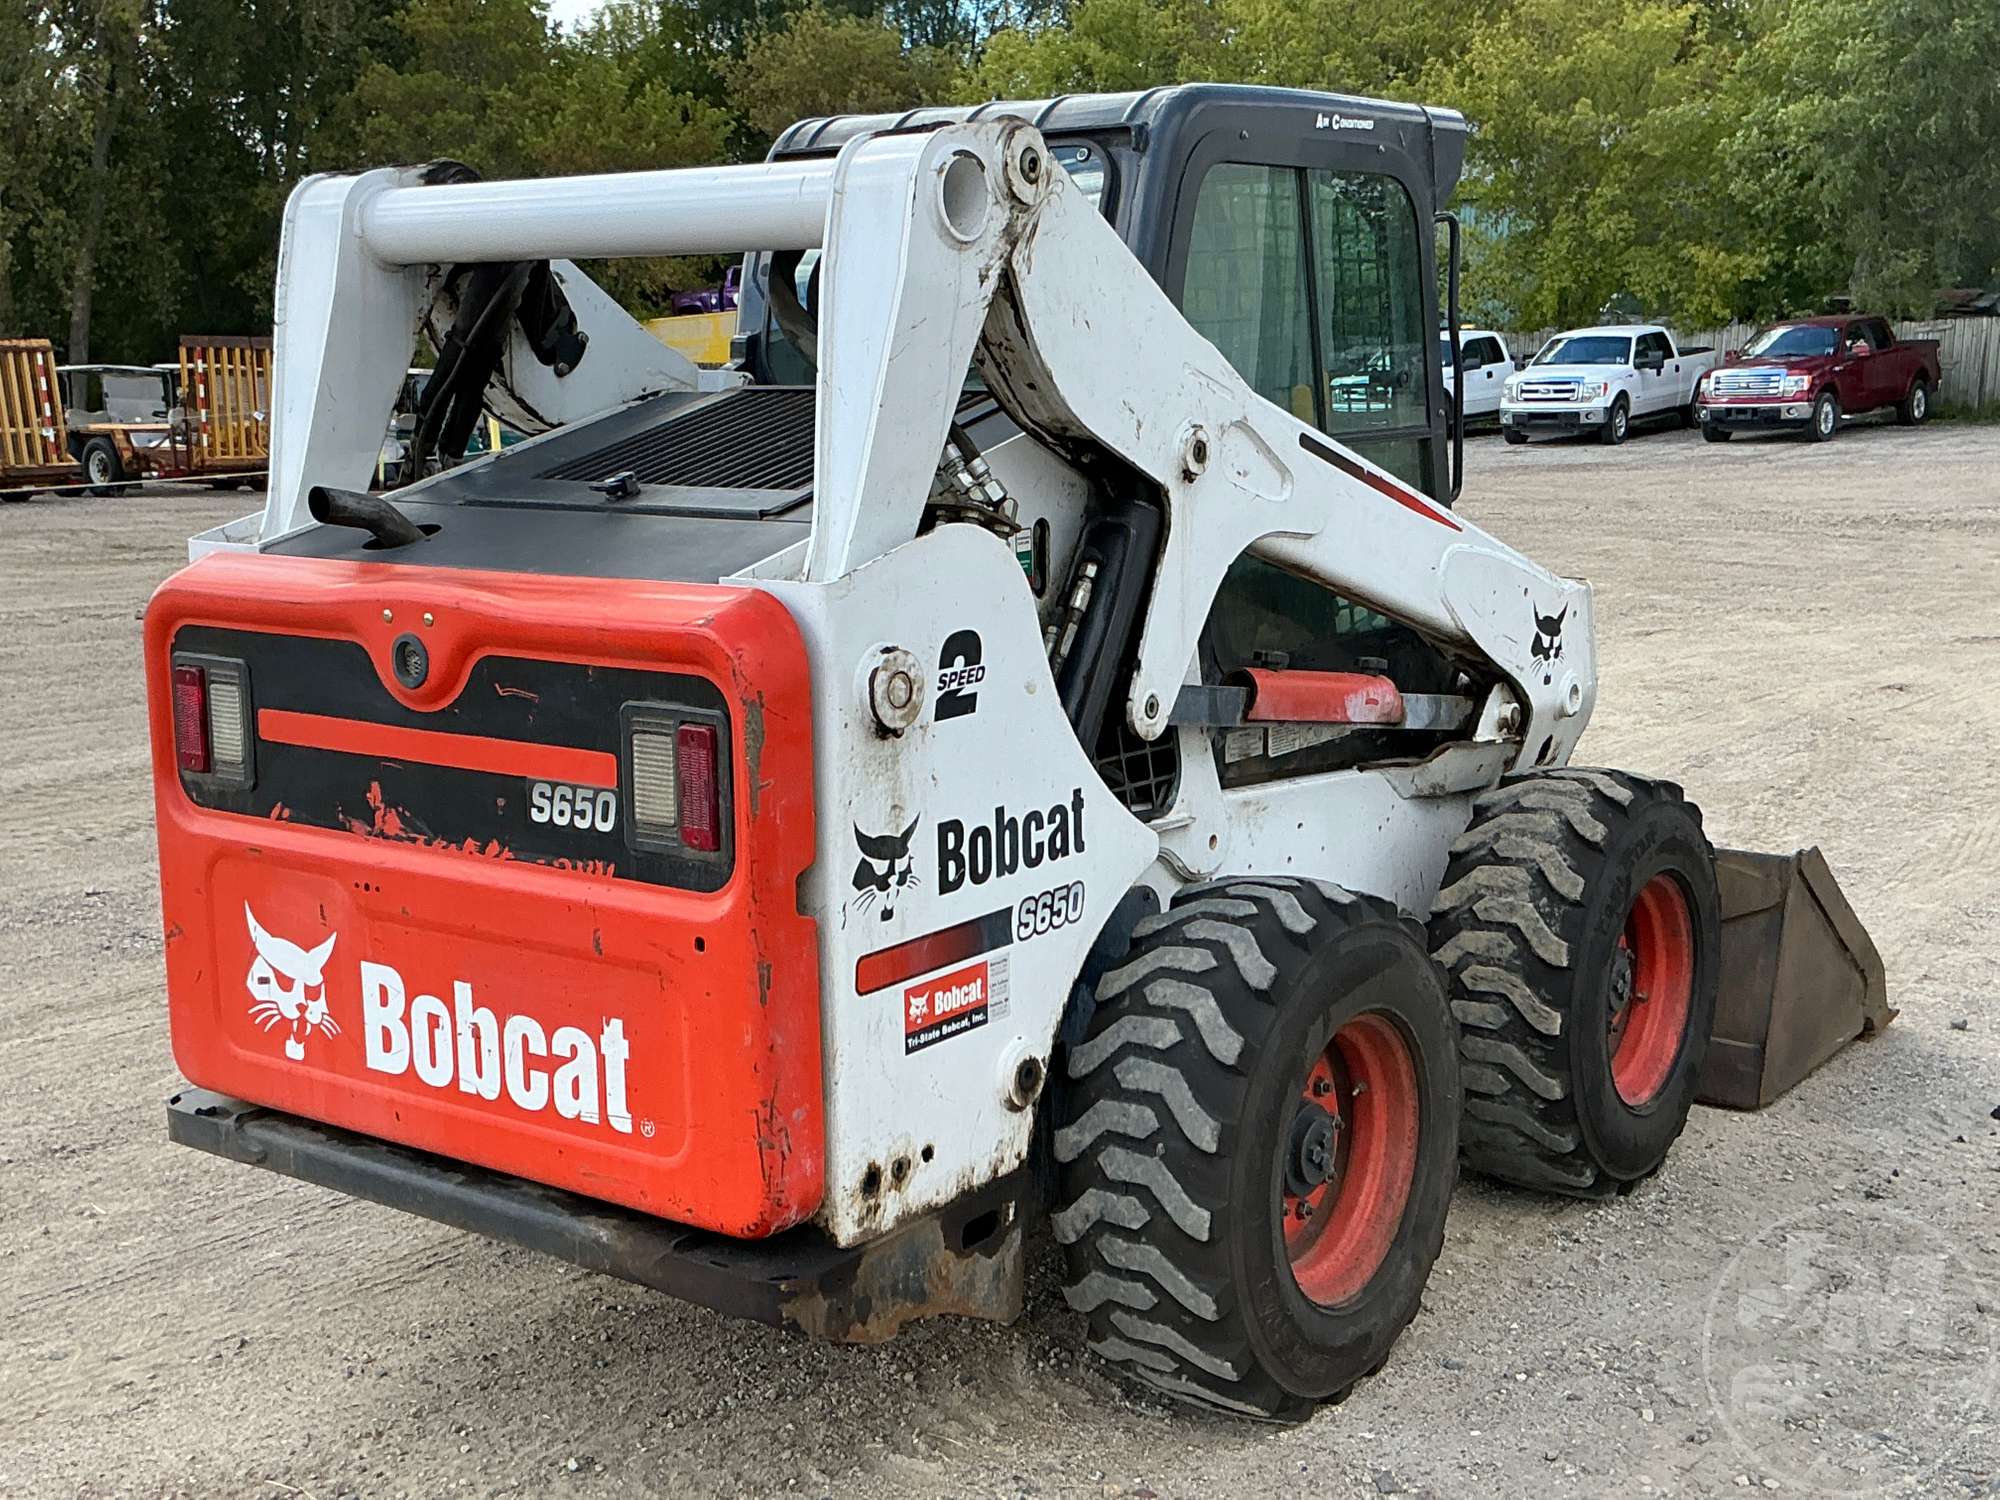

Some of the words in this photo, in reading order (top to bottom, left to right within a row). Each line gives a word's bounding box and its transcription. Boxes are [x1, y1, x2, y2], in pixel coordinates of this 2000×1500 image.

[937, 665, 986, 692] SPEED
[531, 783, 616, 832] S650
[937, 787, 1085, 896] Bobcat
[1017, 880, 1085, 941] S650
[934, 977, 983, 1016] Bobcat
[360, 960, 633, 1134] Bobcat
[907, 1029, 940, 1049] Tri-State
[941, 1017, 971, 1036] Bobcat,
[972, 1012, 986, 1023] Inc.
